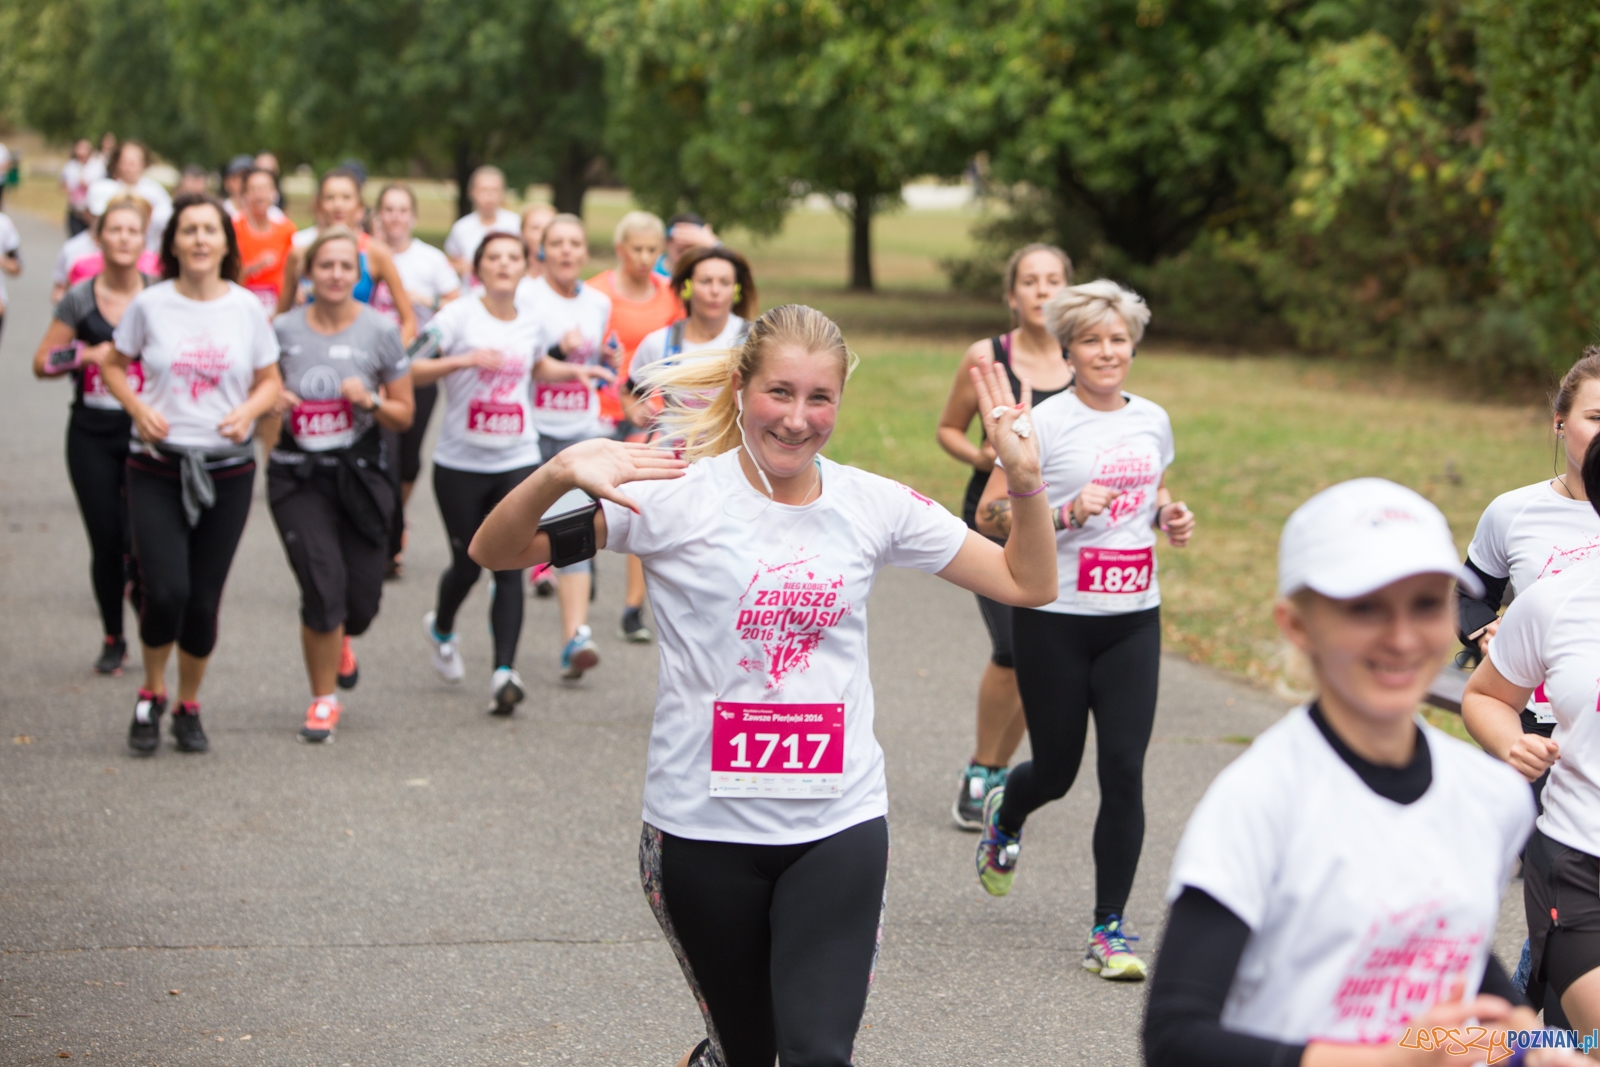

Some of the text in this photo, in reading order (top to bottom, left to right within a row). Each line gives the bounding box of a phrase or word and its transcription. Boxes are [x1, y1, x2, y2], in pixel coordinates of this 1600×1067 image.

[296, 410, 348, 435] 1484
[783, 582, 828, 591] BIEG KOBIET
[1088, 565, 1149, 592] 1824
[754, 590, 837, 608] zawsze
[735, 607, 846, 632] pier(w)si!
[740, 627, 774, 641] 2016
[742, 713, 771, 721] Zawsze
[804, 714, 824, 722] 2016
[729, 732, 831, 769] 1717
